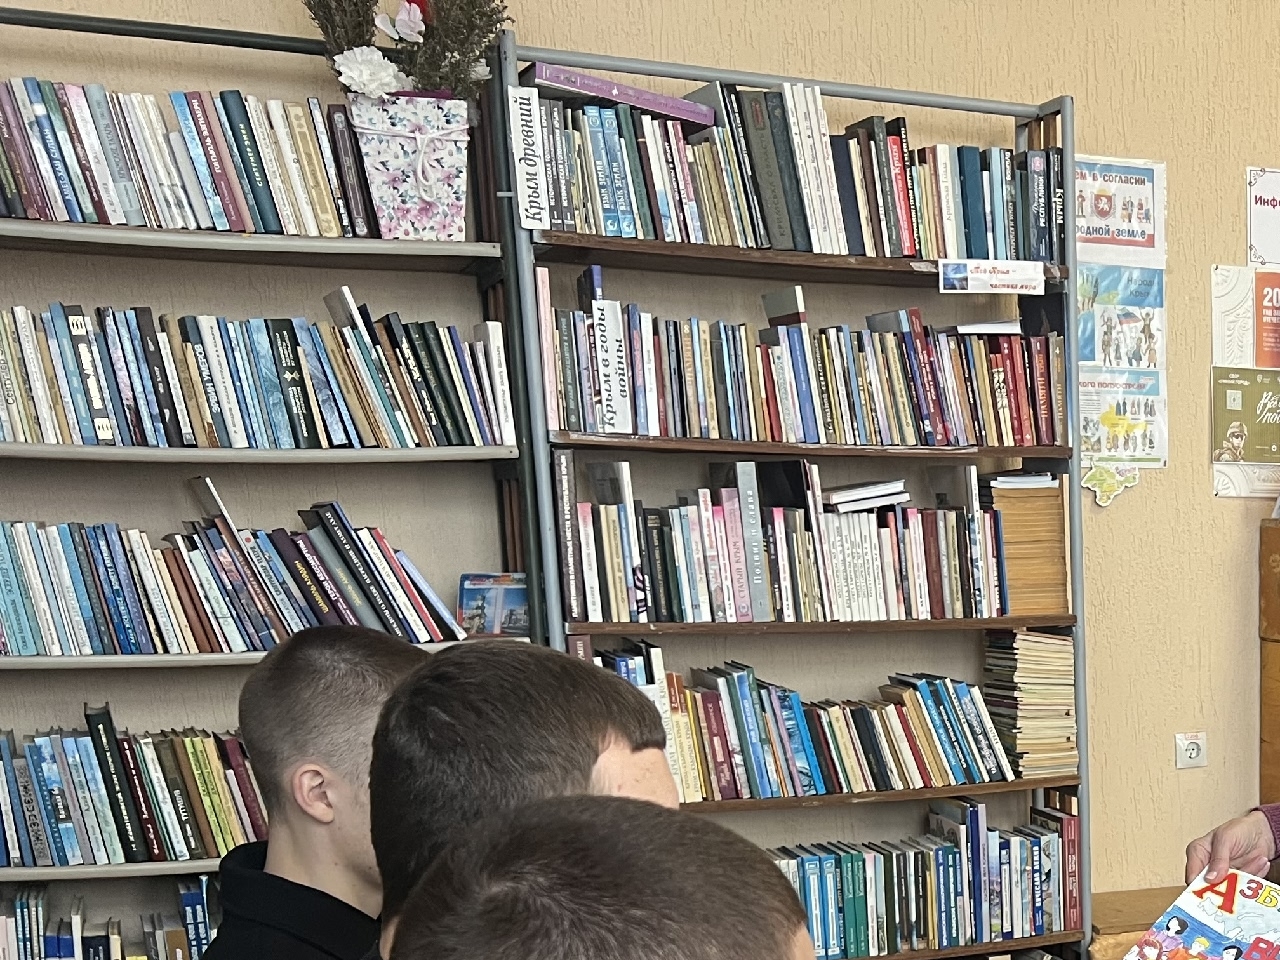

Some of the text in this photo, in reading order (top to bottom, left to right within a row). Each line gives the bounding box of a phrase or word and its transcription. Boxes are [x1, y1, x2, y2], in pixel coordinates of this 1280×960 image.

[514, 96, 545, 222] Крым древний
[1093, 172, 1146, 186] в согласии
[1052, 189, 1063, 224] Крым
[1115, 228, 1146, 239] земле
[596, 305, 617, 428] Крым в годы
[614, 338, 628, 398] войны
